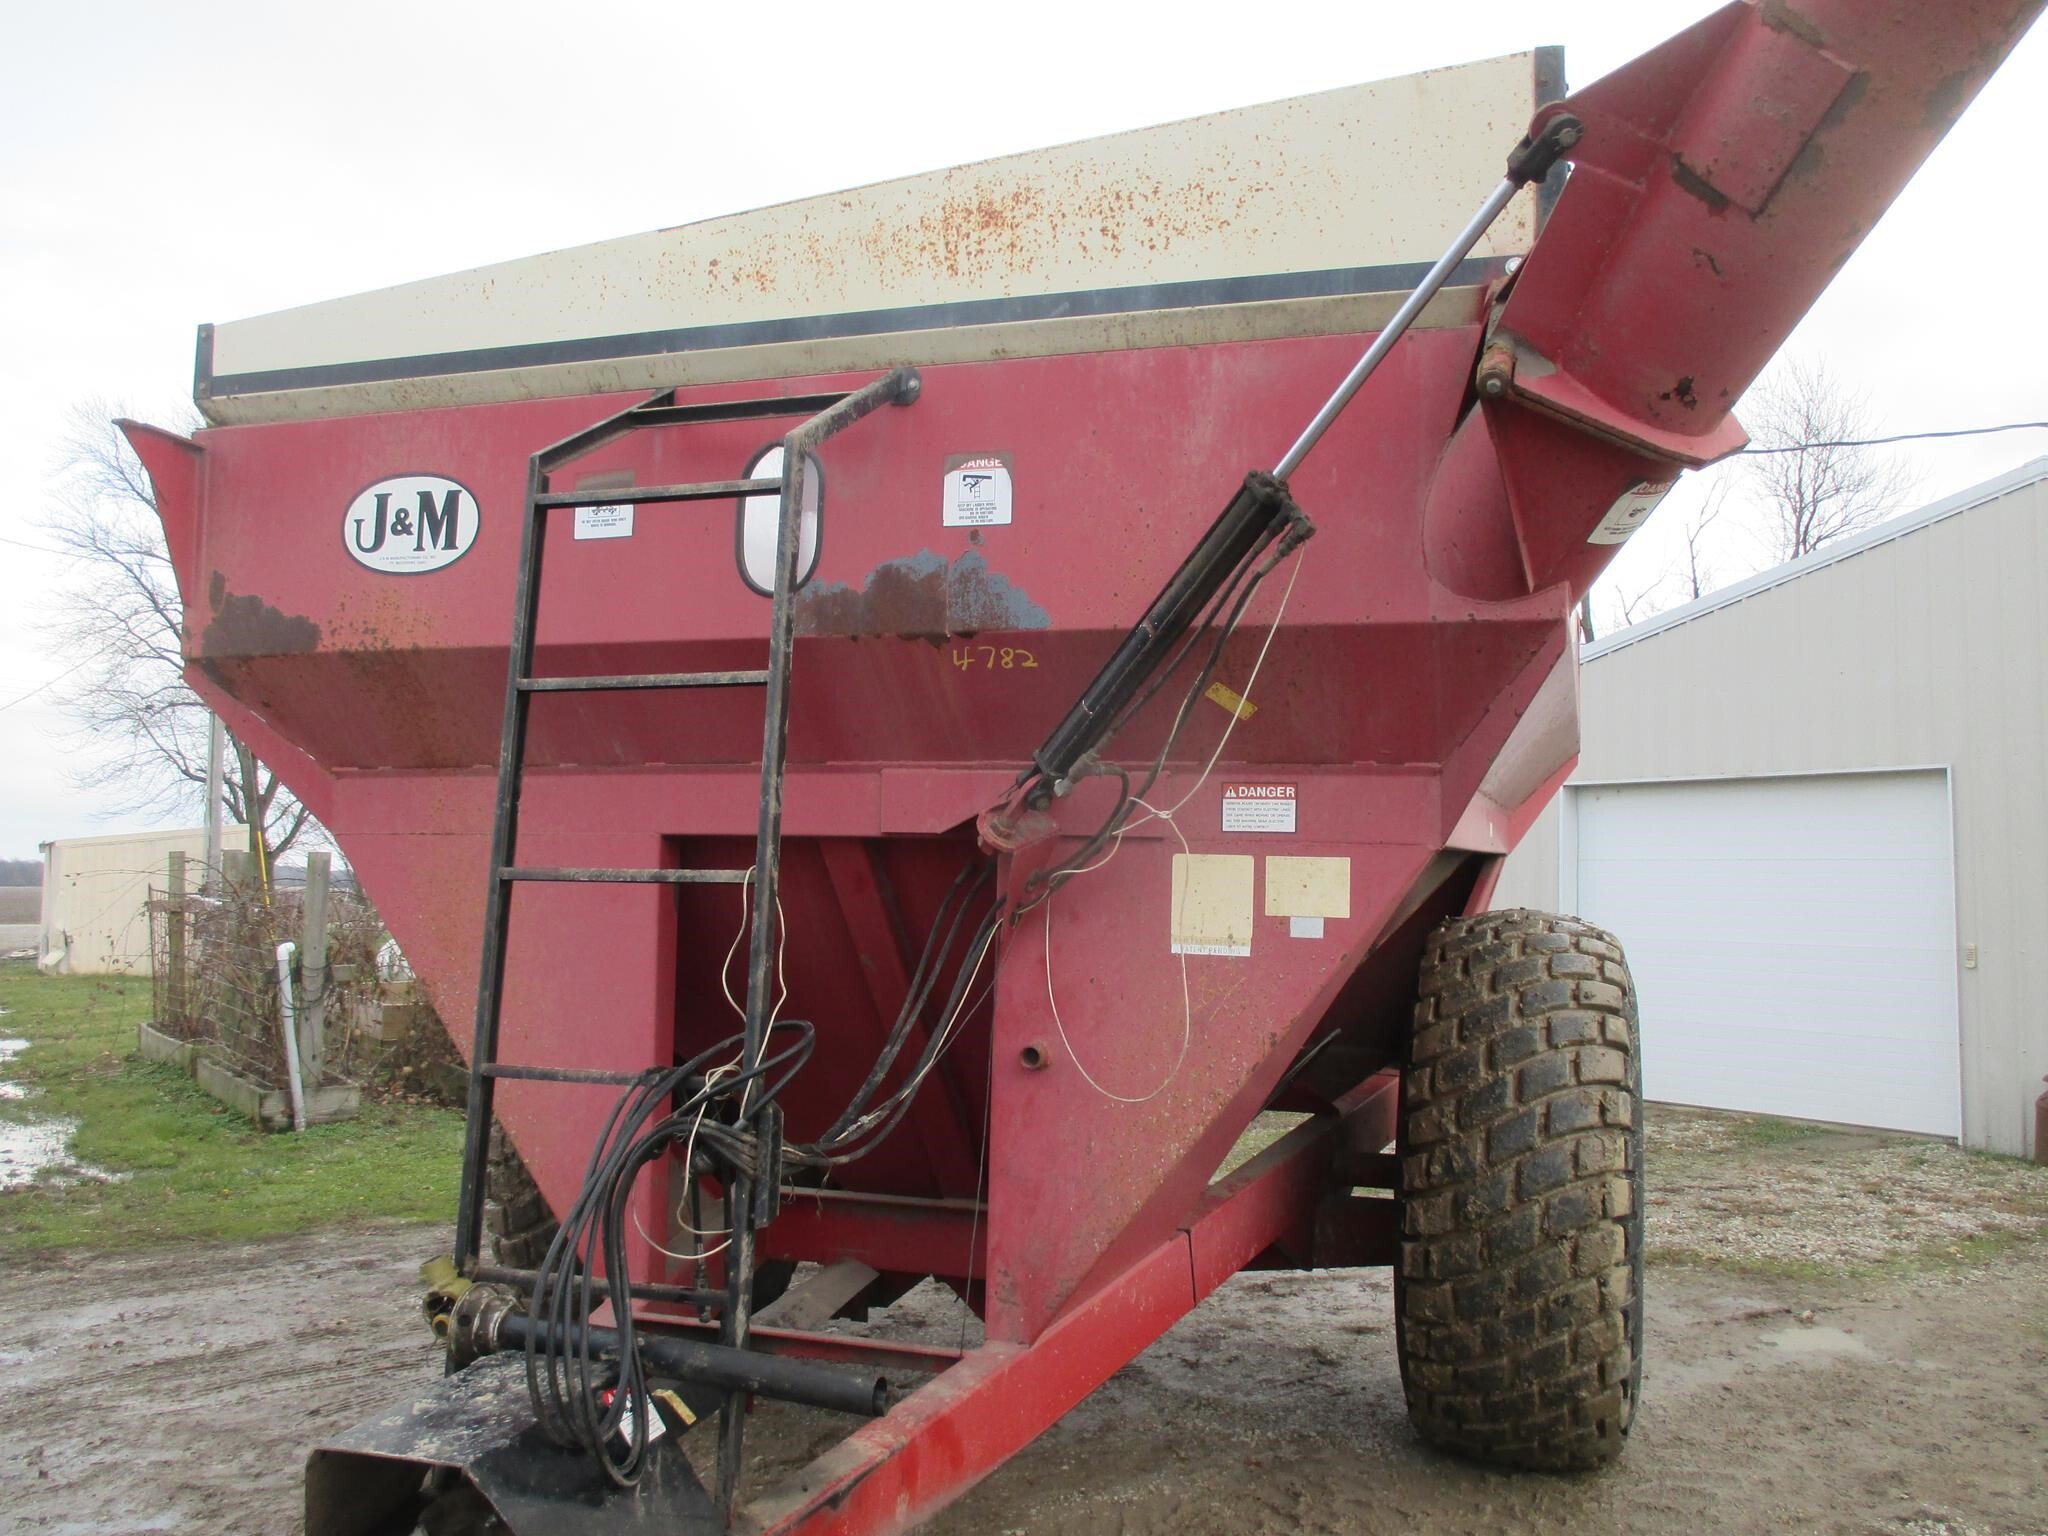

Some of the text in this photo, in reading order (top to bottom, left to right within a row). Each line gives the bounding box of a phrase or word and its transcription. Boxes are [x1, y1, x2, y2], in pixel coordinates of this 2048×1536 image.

[354, 489, 463, 553] J&M
[952, 645, 1039, 671] 4782
[1238, 786, 1296, 798] DANGER
